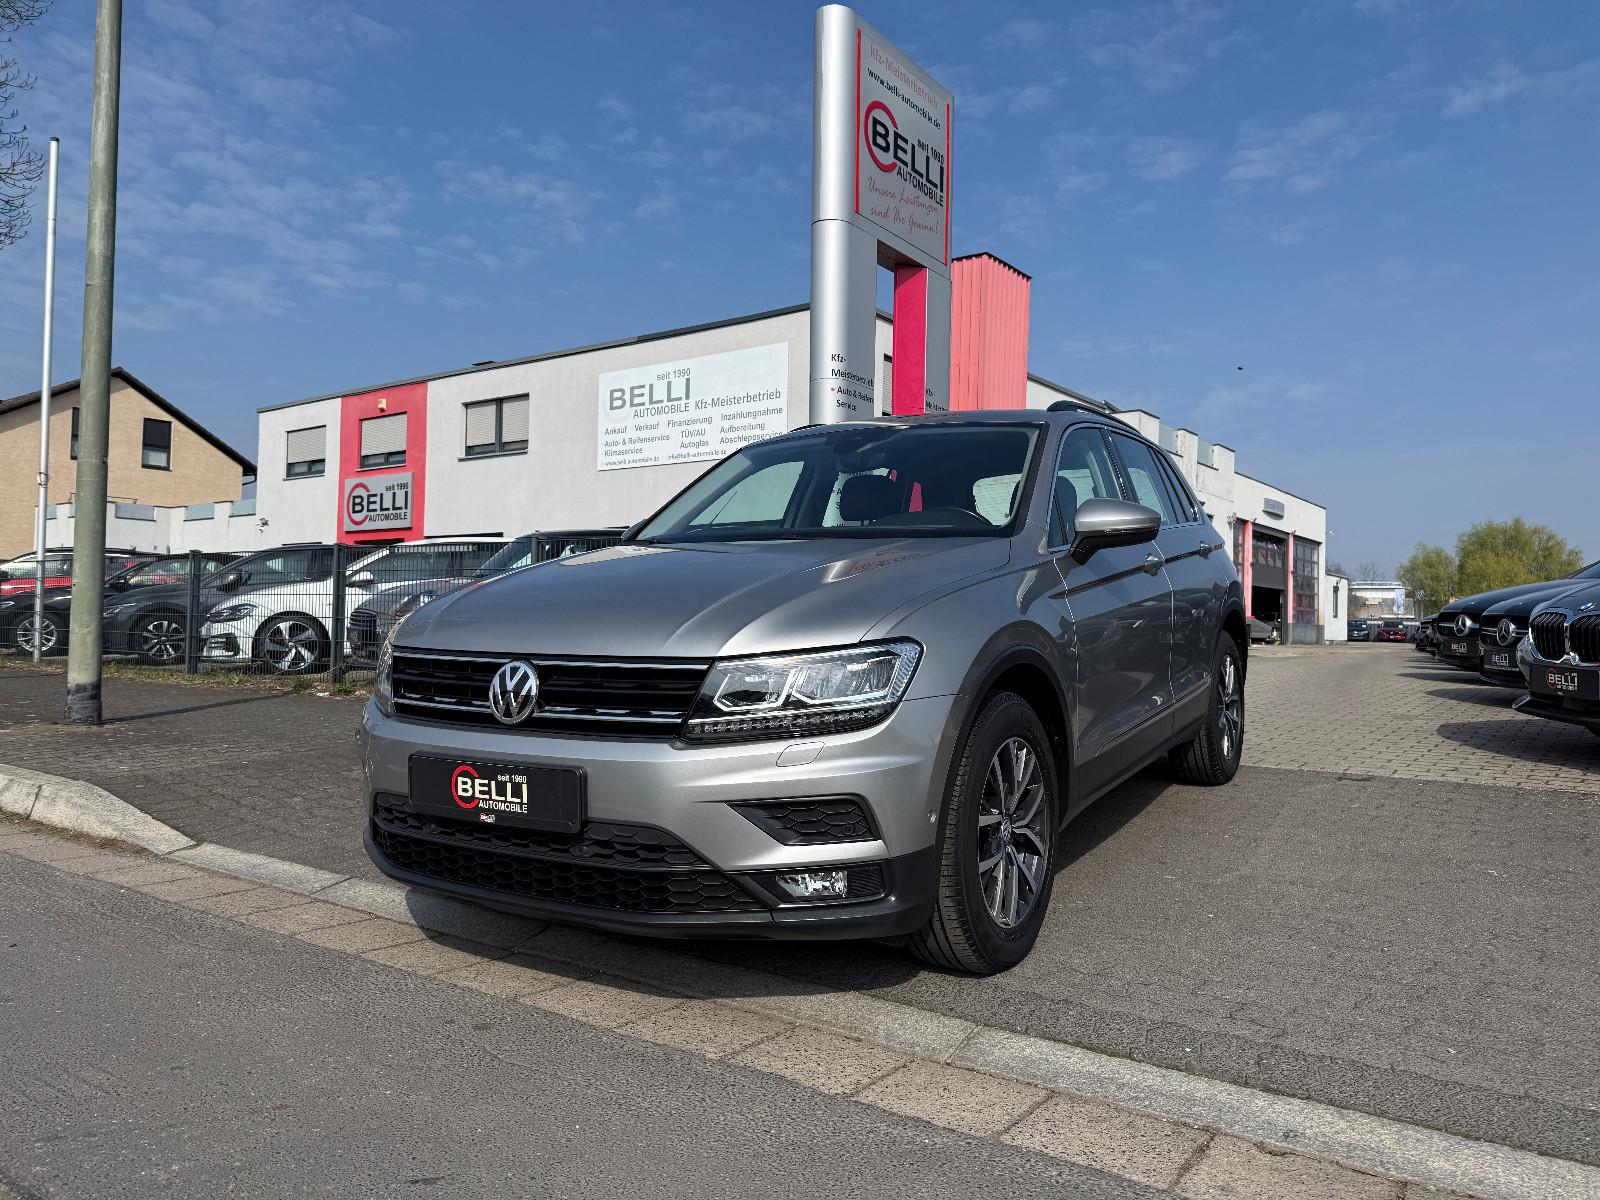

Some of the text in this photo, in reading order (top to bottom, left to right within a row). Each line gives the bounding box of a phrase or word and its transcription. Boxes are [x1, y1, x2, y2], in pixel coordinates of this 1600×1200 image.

[870, 45, 939, 108] Kfz-Meisterbetrieb
[867, 66, 941, 130] www.belli-automobile.de
[917, 138, 929, 154] seit
[872, 116, 945, 193] BELLI
[896, 165, 944, 207] AUTOMOBILE
[831, 353, 847, 363] Kfz-
[656, 367, 691, 381] seit 1990
[609, 377, 691, 411] BELLI
[694, 388, 781, 411] Kfz-Meisterbetrieb
[633, 402, 690, 419] AUTOMOBILE
[604, 407, 783, 436] Ankauf Verkauf Finanzierung Inzahlungnahme
[720, 421, 766, 434] Aufbereitung
[604, 433, 670, 448] Auto- & Reifenservice
[681, 428, 706, 439] TÜV/AU
[604, 446, 643, 457] Klimaservice
[679, 439, 709, 450] Autoglas
[352, 491, 408, 514] BELLI
[369, 512, 408, 522] AUTOMOBILE
[1548, 673, 1578, 687] BELLI
[497, 774, 527, 784] seit 1990
[457, 776, 528, 804] BELLI
[478, 799, 528, 814] AUTOMOBILE
